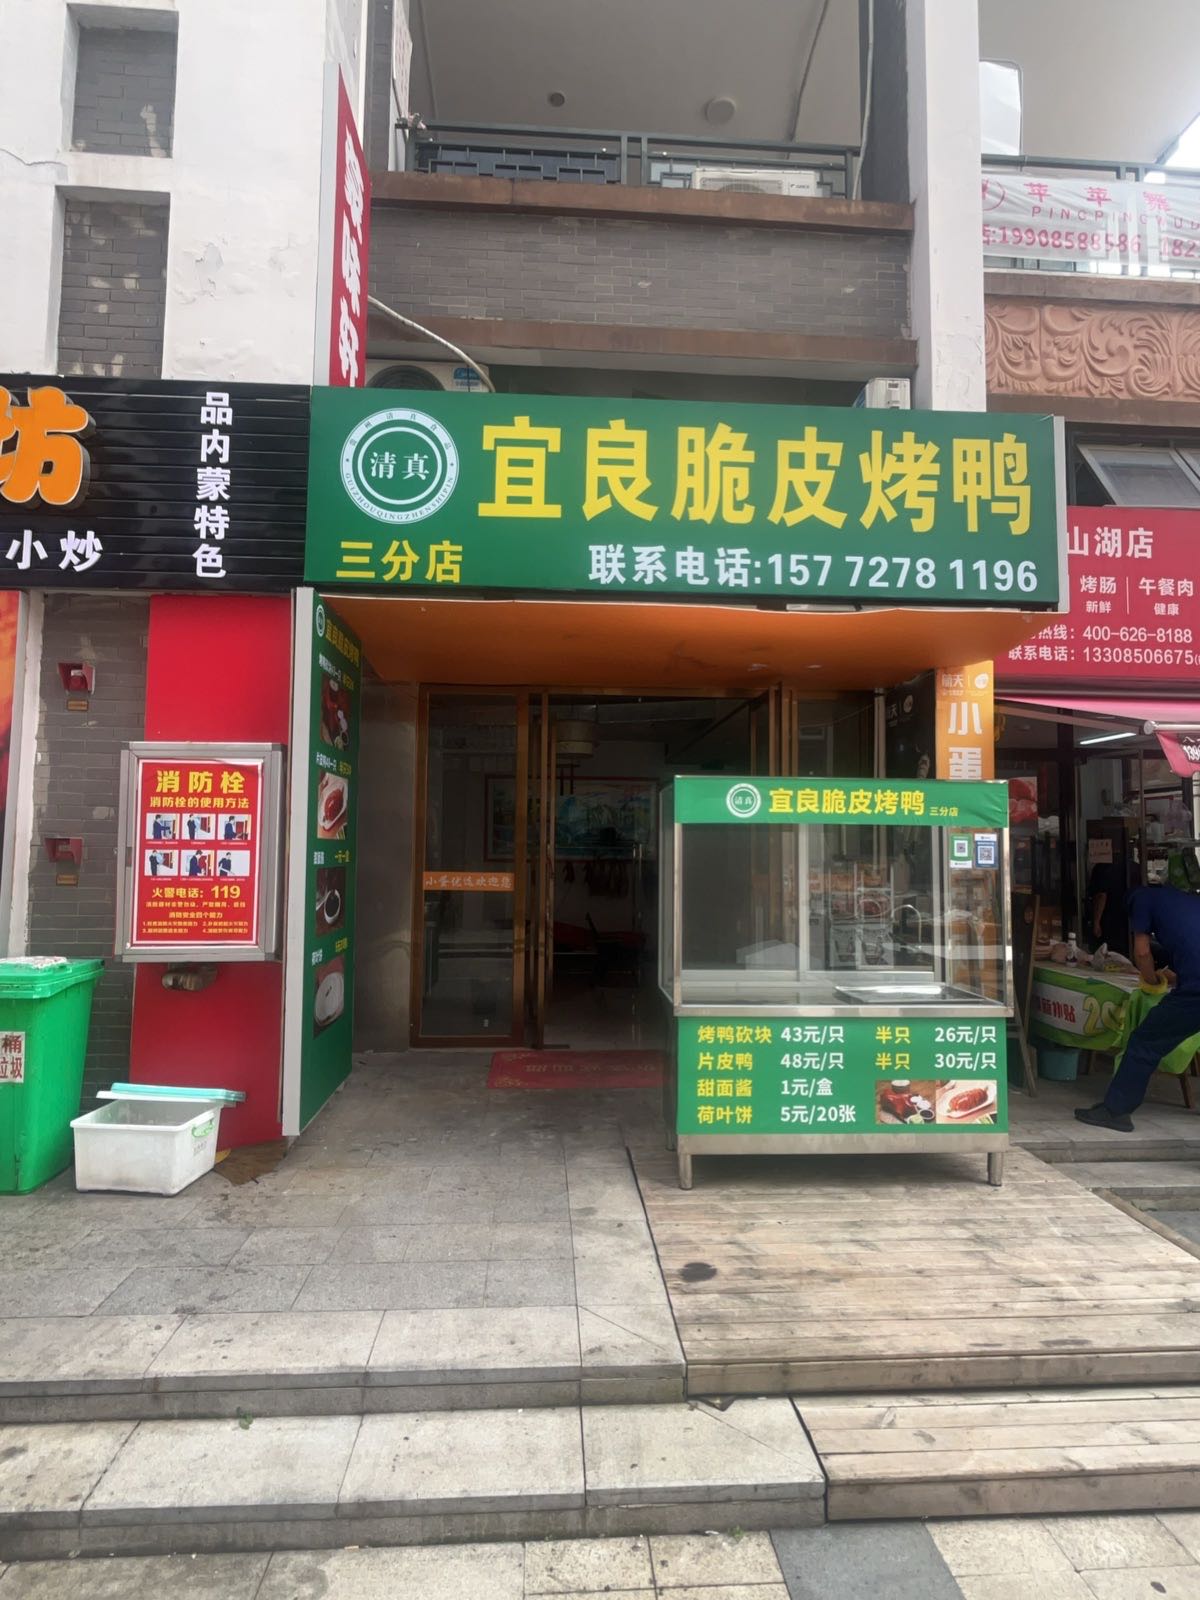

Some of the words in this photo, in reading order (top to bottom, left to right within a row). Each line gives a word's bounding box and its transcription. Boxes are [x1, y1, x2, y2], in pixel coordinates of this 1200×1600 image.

[370, 451, 430, 480] 清真
[478, 415, 1031, 535] 宜良脆皮烤鸭
[192, 391, 233, 578] 品内蒙特色
[5, 530, 103, 572] 小炒
[336, 540, 463, 583] 三分店
[845, 556, 936, 588] 7278
[950, 559, 1038, 592] 1196
[1080, 575, 1117, 594] 烤肠
[1138, 577, 1194, 597] 午餐肉
[1085, 601, 1112, 614] 新鲜
[1154, 603, 1180, 616] 健康
[156, 770, 245, 794] 消防栓
[149, 797, 250, 809] 消防栓的使用方法
[769, 788, 925, 816] 宜良脆皮烤鸭
[929, 807, 959, 818] 三分店
[152, 885, 241, 899] 火警电话：119
[697, 1025, 773, 1044] 烤鸭砍块
[780, 1025, 845, 1044] 43元/只
[875, 1025, 911, 1044] 半只
[934, 1025, 997, 1044] 26元/只
[697, 1051, 753, 1071] 片皮鸭
[780, 1051, 845, 1071] 48元/只
[875, 1051, 911, 1071] 半只
[934, 1051, 997, 1071] 30元/只
[697, 1078, 753, 1097] 甜面酱
[780, 1078, 833, 1097] 1元/盒
[697, 1105, 753, 1124] 荷叶饼
[780, 1105, 856, 1124] 5元/20张
